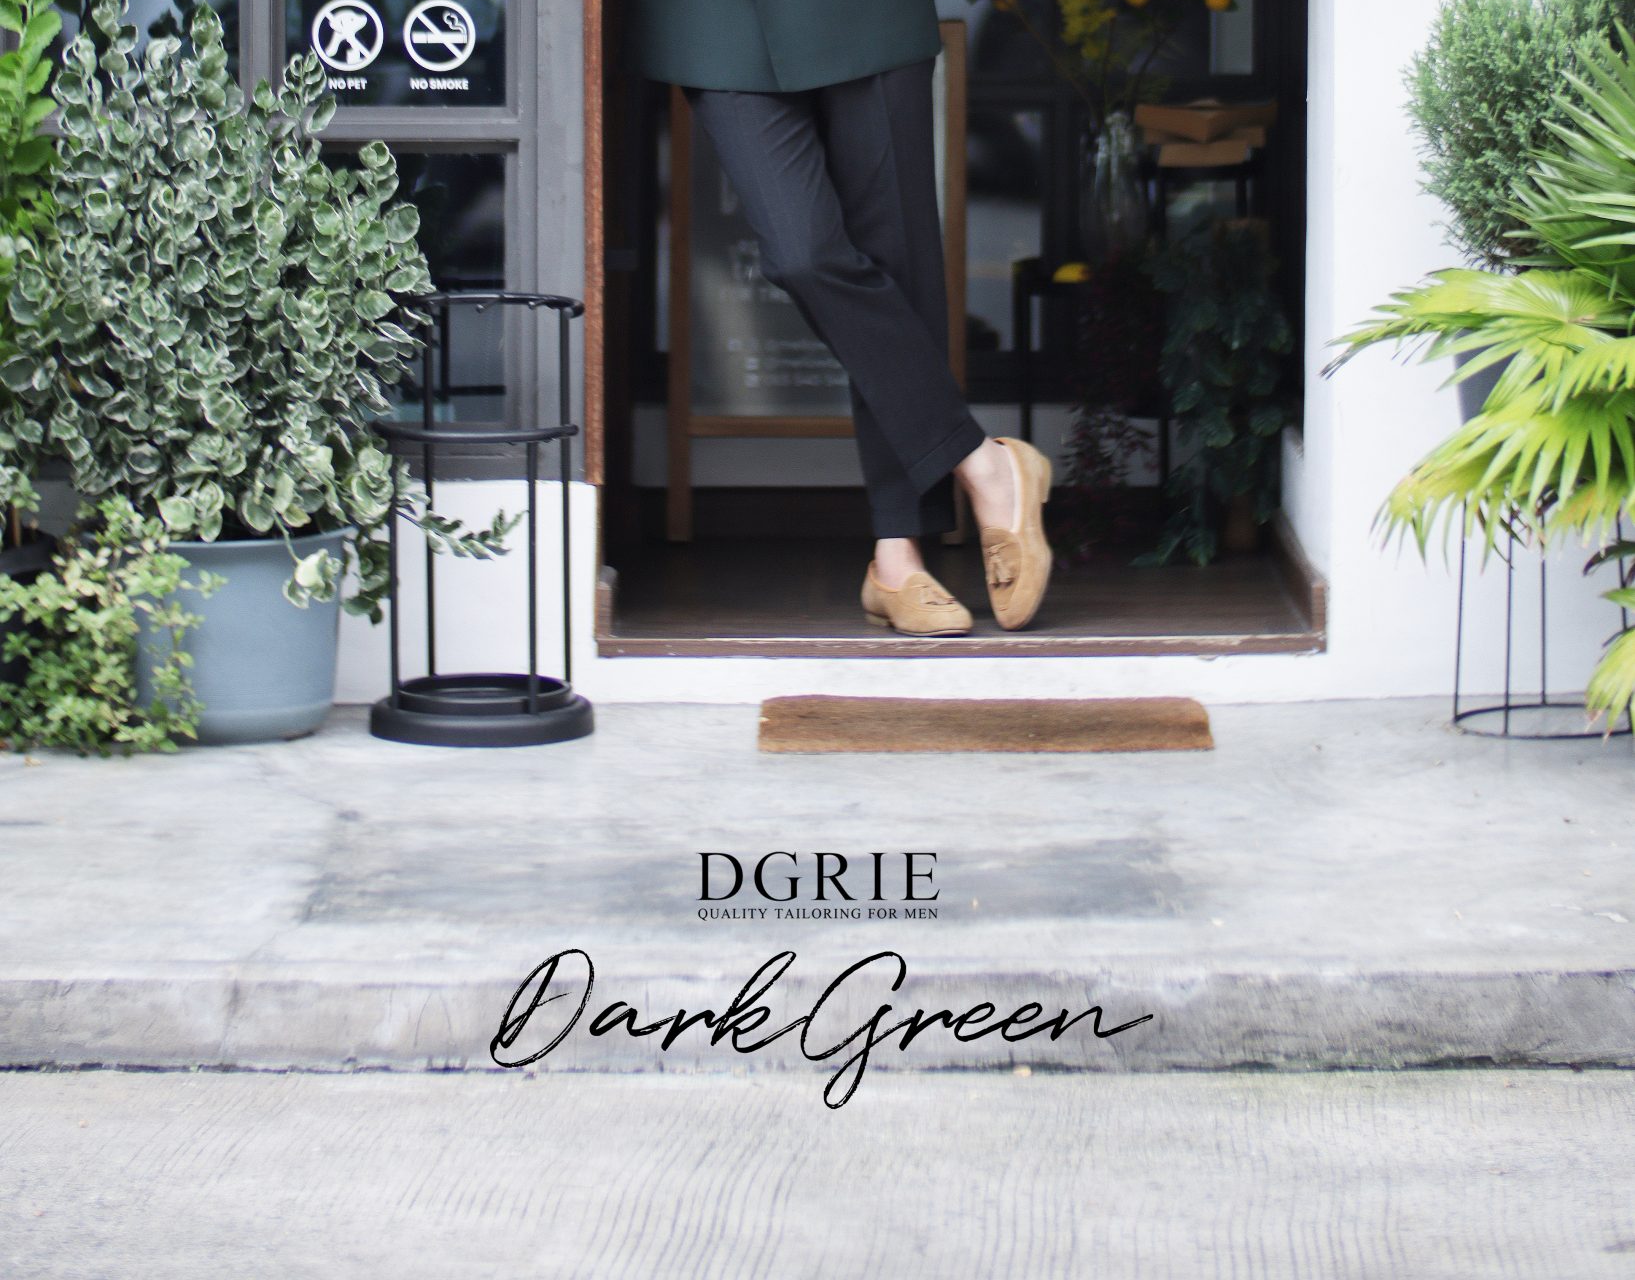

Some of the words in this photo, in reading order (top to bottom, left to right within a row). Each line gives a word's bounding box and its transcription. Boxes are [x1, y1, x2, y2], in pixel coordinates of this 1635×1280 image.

[328, 77, 346, 91] NO
[347, 77, 367, 91] PET
[410, 77, 428, 91] NO
[429, 77, 469, 91] SMOKE
